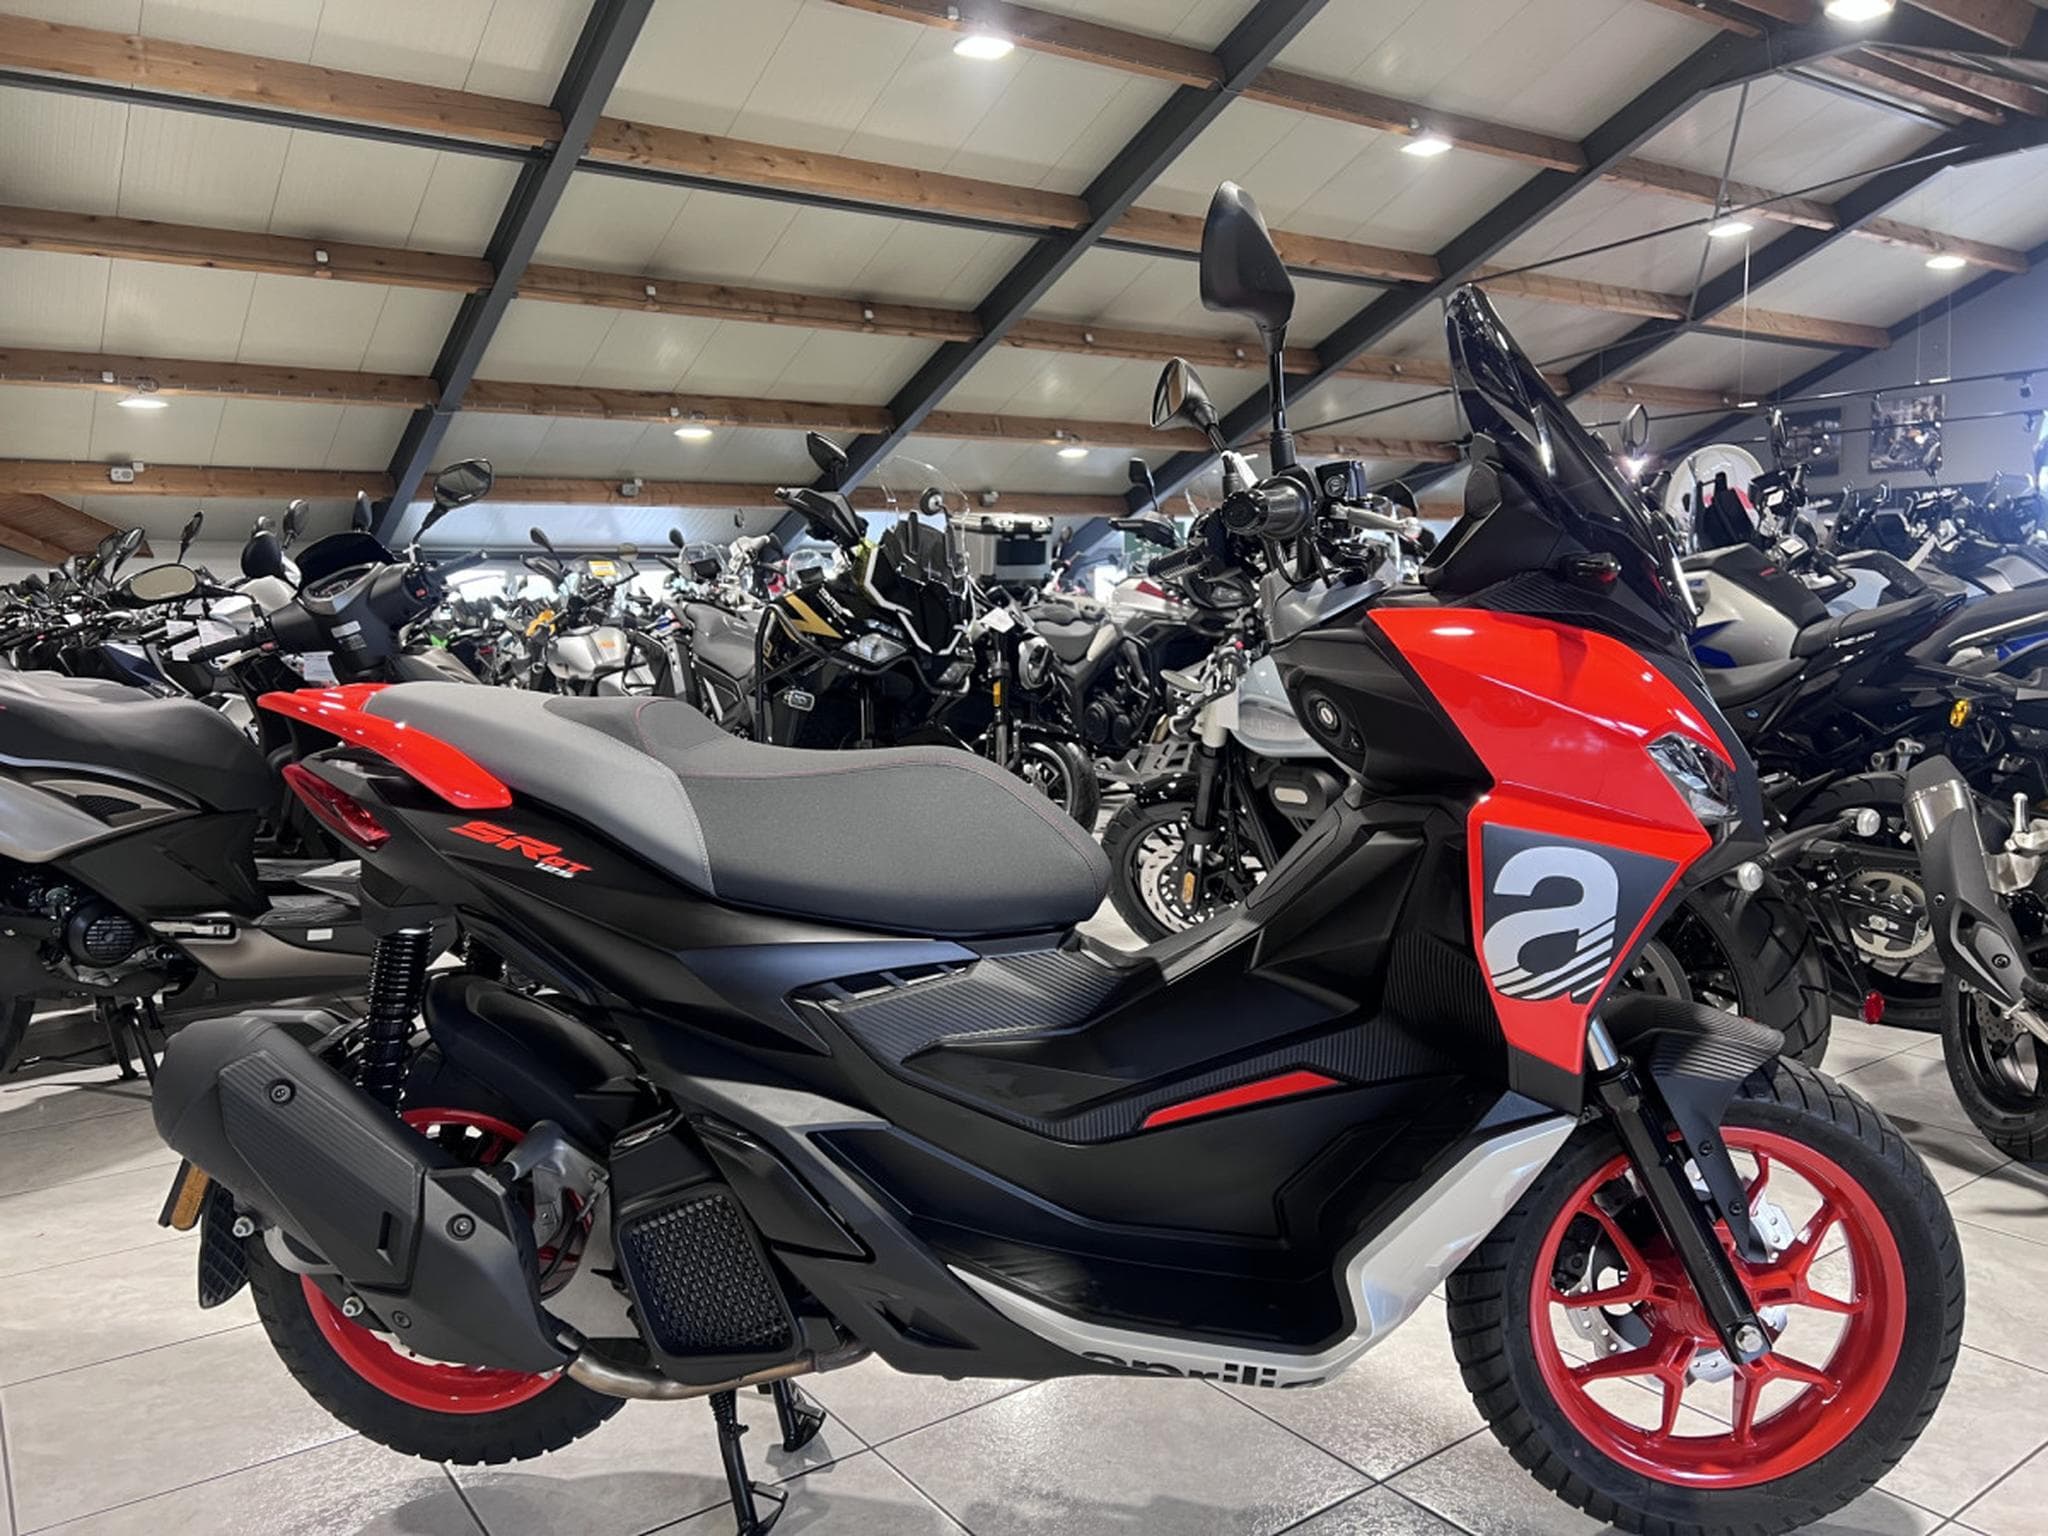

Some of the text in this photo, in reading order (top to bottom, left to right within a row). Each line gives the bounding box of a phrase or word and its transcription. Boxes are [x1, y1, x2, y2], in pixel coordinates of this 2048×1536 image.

[448, 821, 592, 873] SR GT
[1482, 846, 1619, 1000] a
